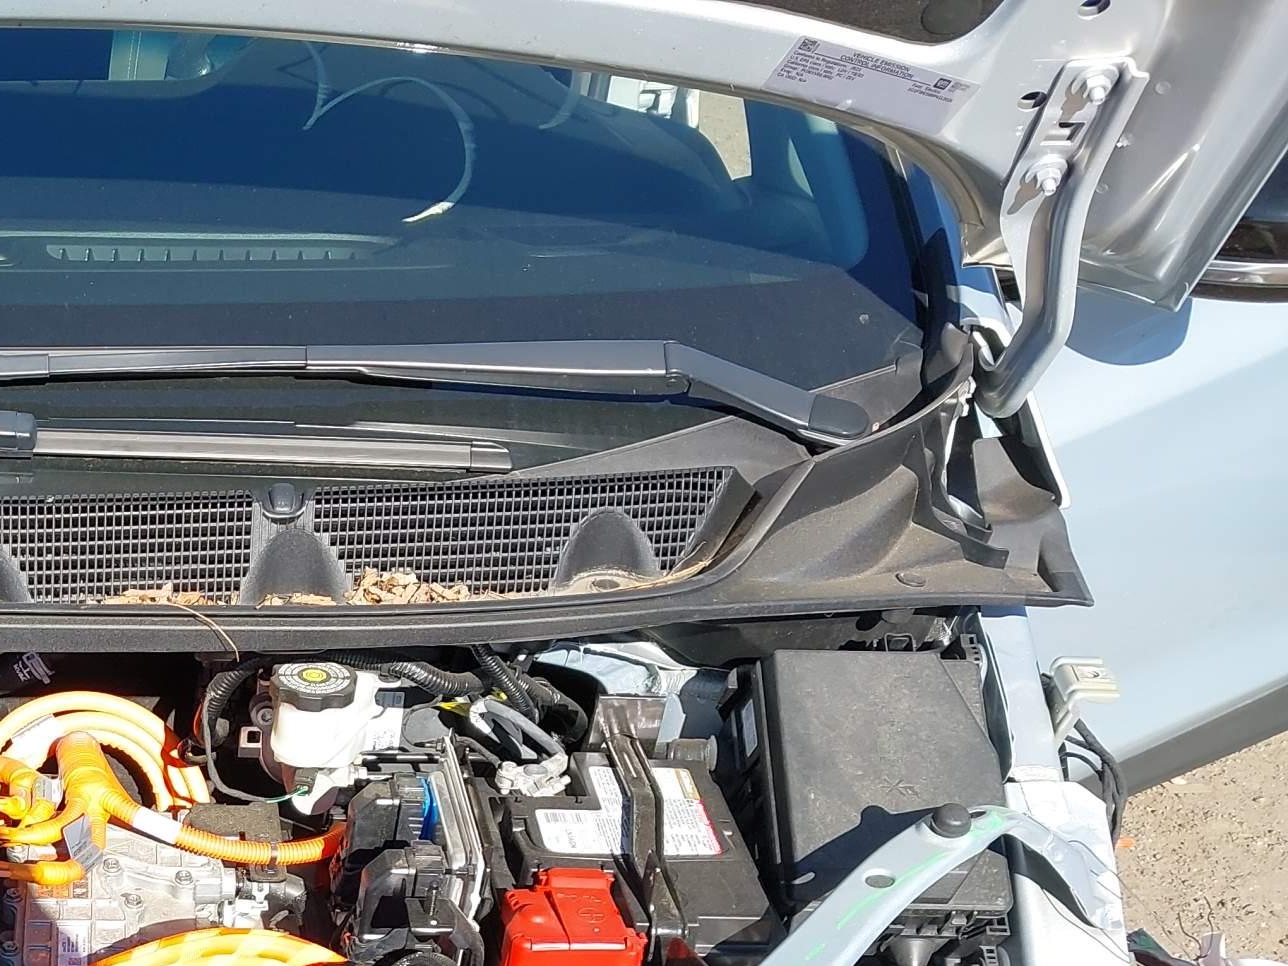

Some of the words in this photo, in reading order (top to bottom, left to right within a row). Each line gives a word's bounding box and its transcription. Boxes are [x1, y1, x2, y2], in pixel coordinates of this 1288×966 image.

[840, 55, 871, 67] CONTROL
[871, 63, 914, 78] INFORMATION
[853, 53, 879, 64] VEHICLE
[881, 60, 910, 71] EMISSION
